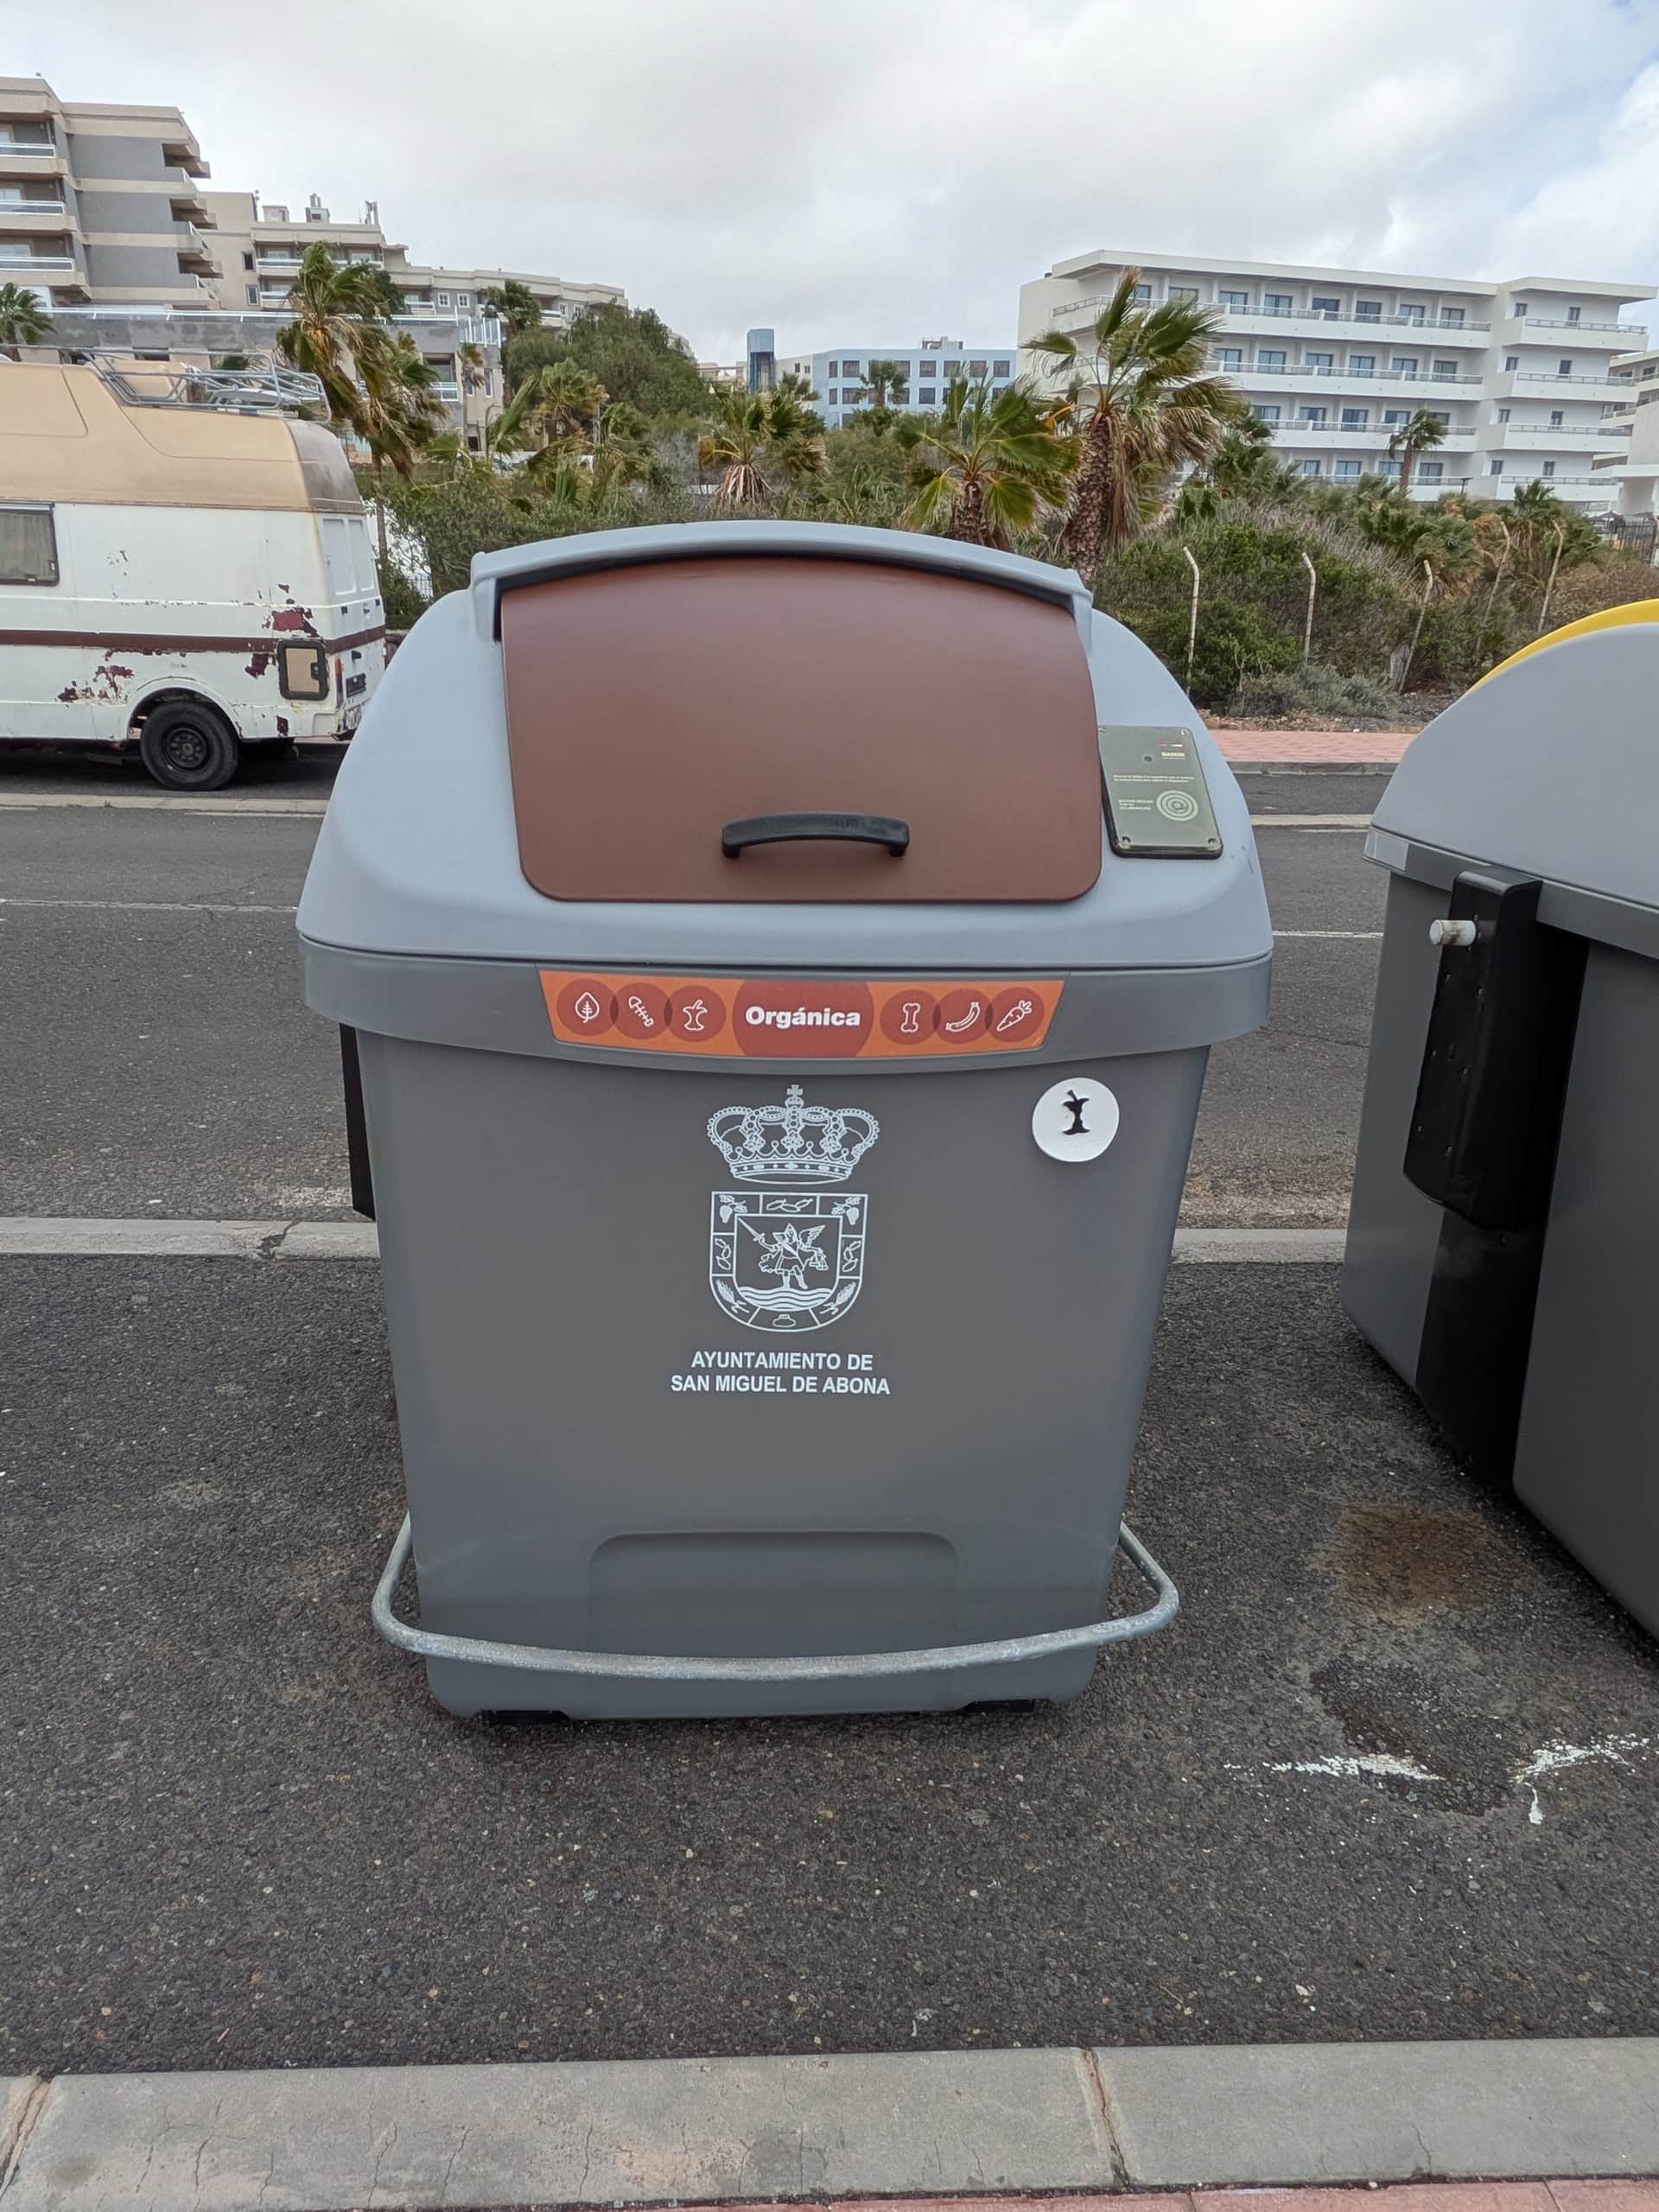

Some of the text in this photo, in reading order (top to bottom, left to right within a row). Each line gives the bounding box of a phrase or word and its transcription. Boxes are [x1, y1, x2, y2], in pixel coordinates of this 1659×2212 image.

[746, 1006, 861, 1029] Orgánica
[691, 1351, 874, 1370] AYUNTAMIENTO DE
[671, 1375, 891, 1395] SAN MIGUEL DE ABONA
